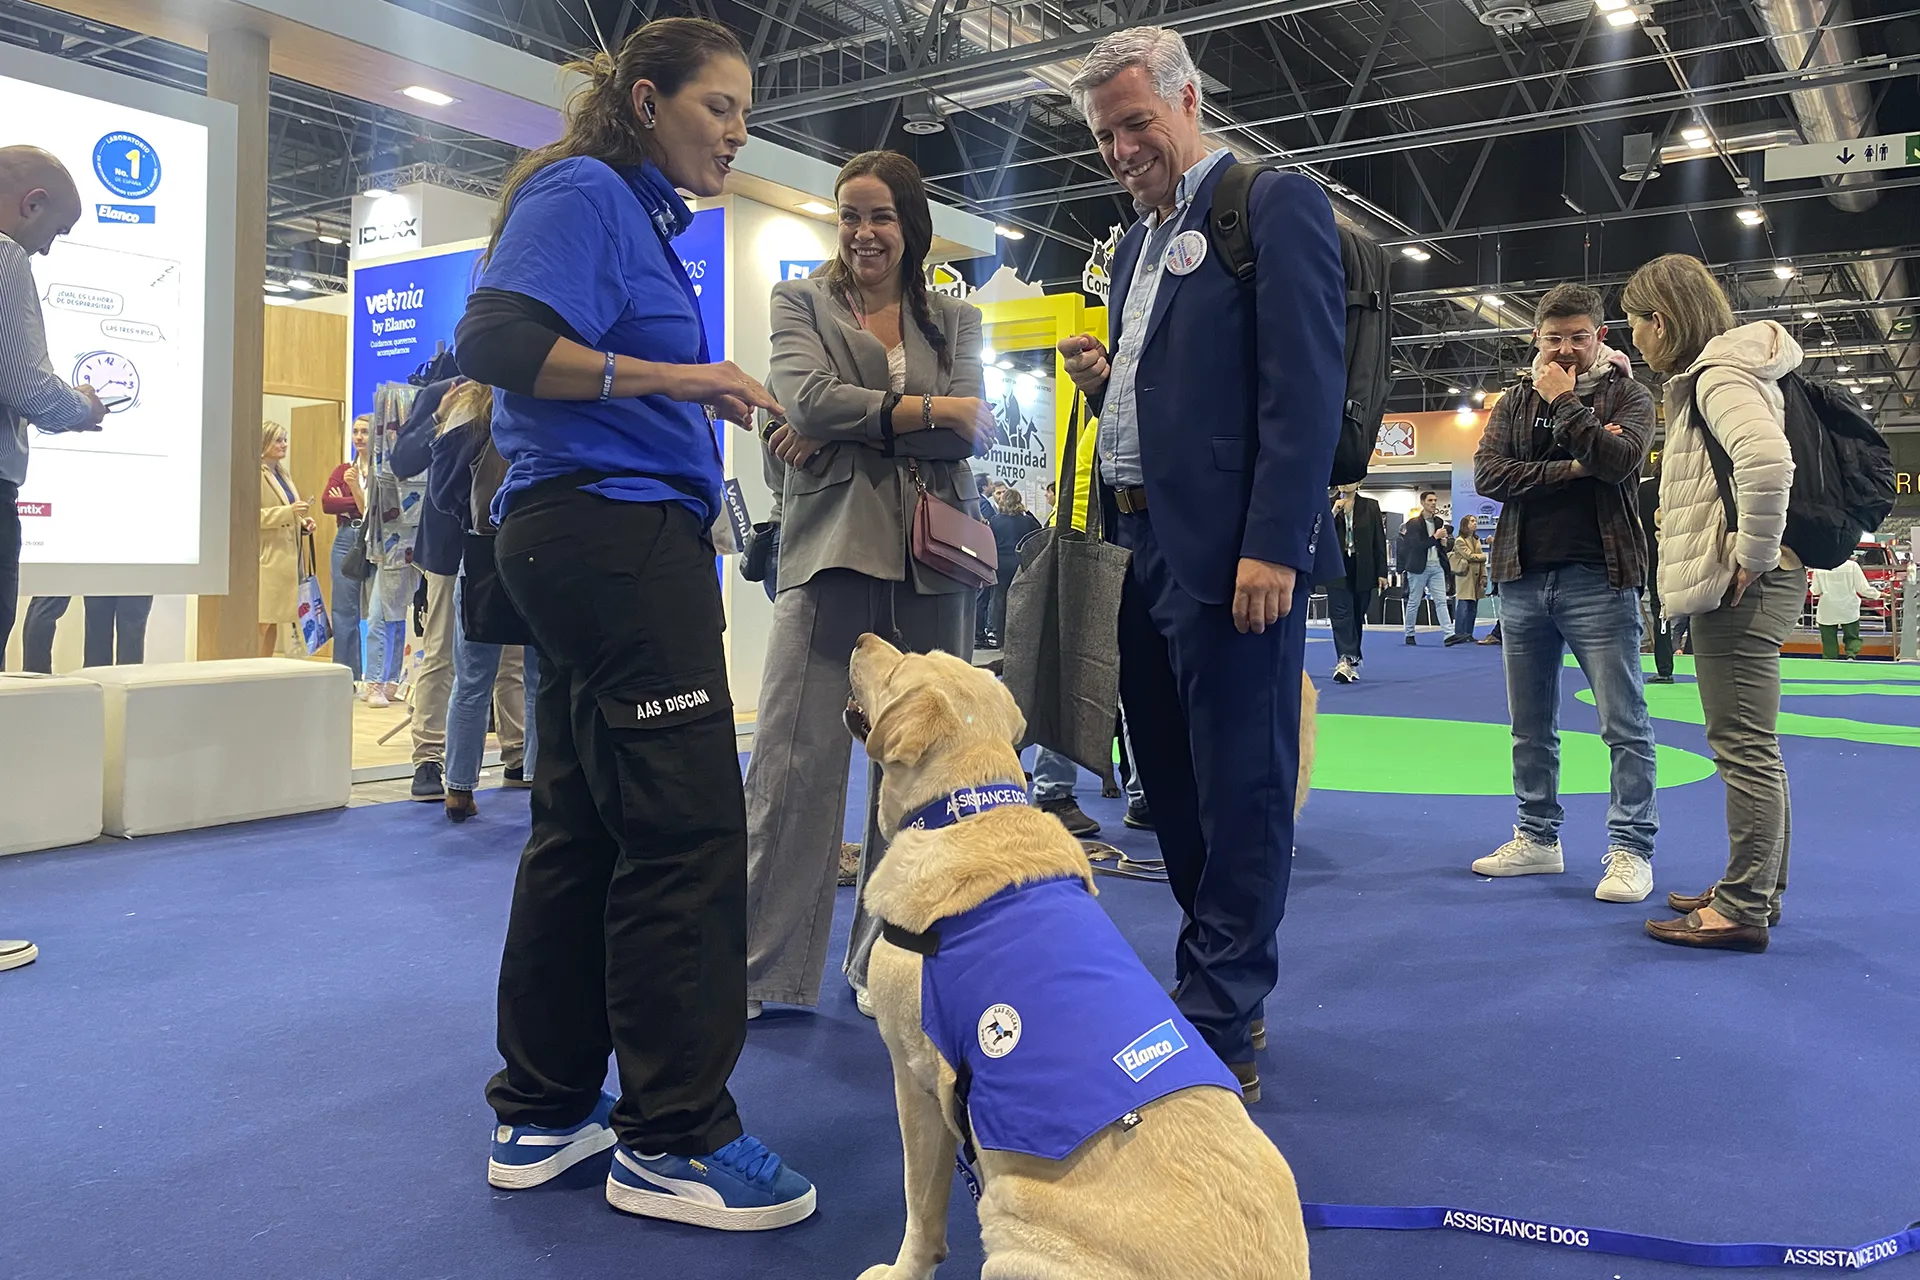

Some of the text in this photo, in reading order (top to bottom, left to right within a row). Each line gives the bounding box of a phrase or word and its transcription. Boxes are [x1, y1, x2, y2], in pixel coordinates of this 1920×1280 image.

[105, 134, 151, 154] LABORATORIO
[98, 204, 141, 223] Elanco
[372, 317, 416, 337] by Elanco
[104, 356, 115, 365] 12
[996, 465, 1026, 480] FATRO
[636, 689, 710, 720] AAS DISCAN
[1122, 1040, 1173, 1071] Elanco
[1443, 1210, 1590, 1247] ASSISTANCE DOG
[1783, 1239, 1898, 1269] ASSISTANCE DOG
